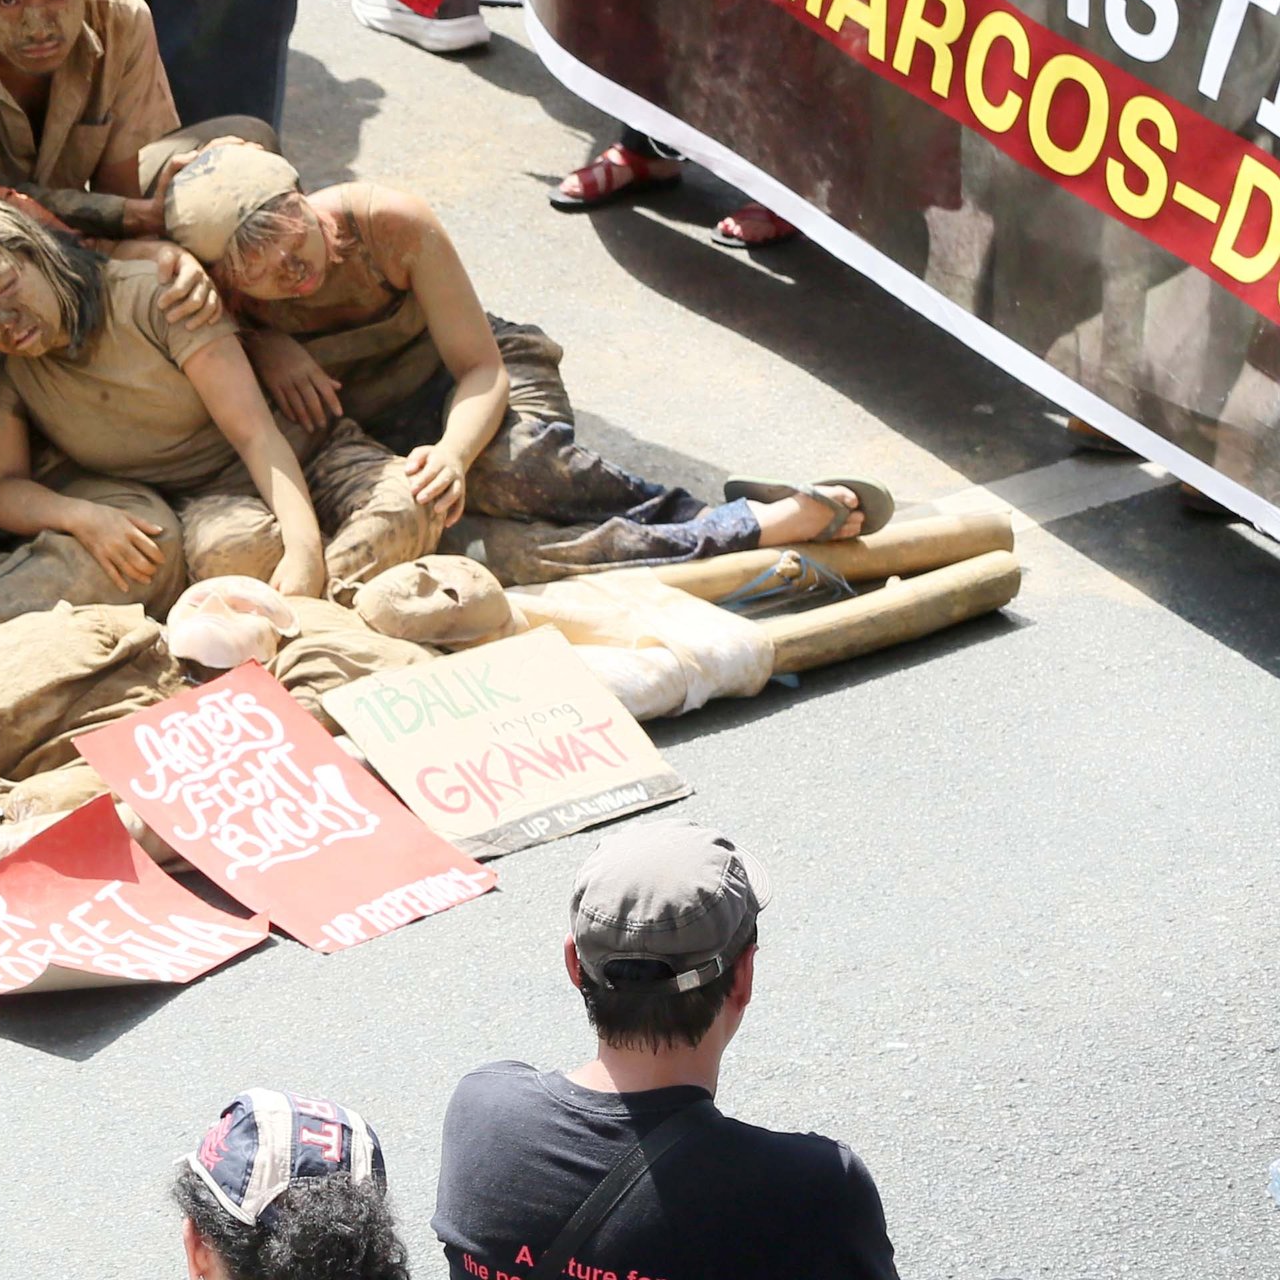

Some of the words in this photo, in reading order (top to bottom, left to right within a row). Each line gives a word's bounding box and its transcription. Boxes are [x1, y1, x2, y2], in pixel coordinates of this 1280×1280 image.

[490, 702, 583, 738] inyong
[416, 718, 629, 821] GIKAWAT
[173, 742, 313, 841] FIGHT
[208, 764, 381, 880] BACK!
[520, 817, 551, 839] UP
[463, 1252, 489, 1280] the
[514, 1245, 535, 1267] A
